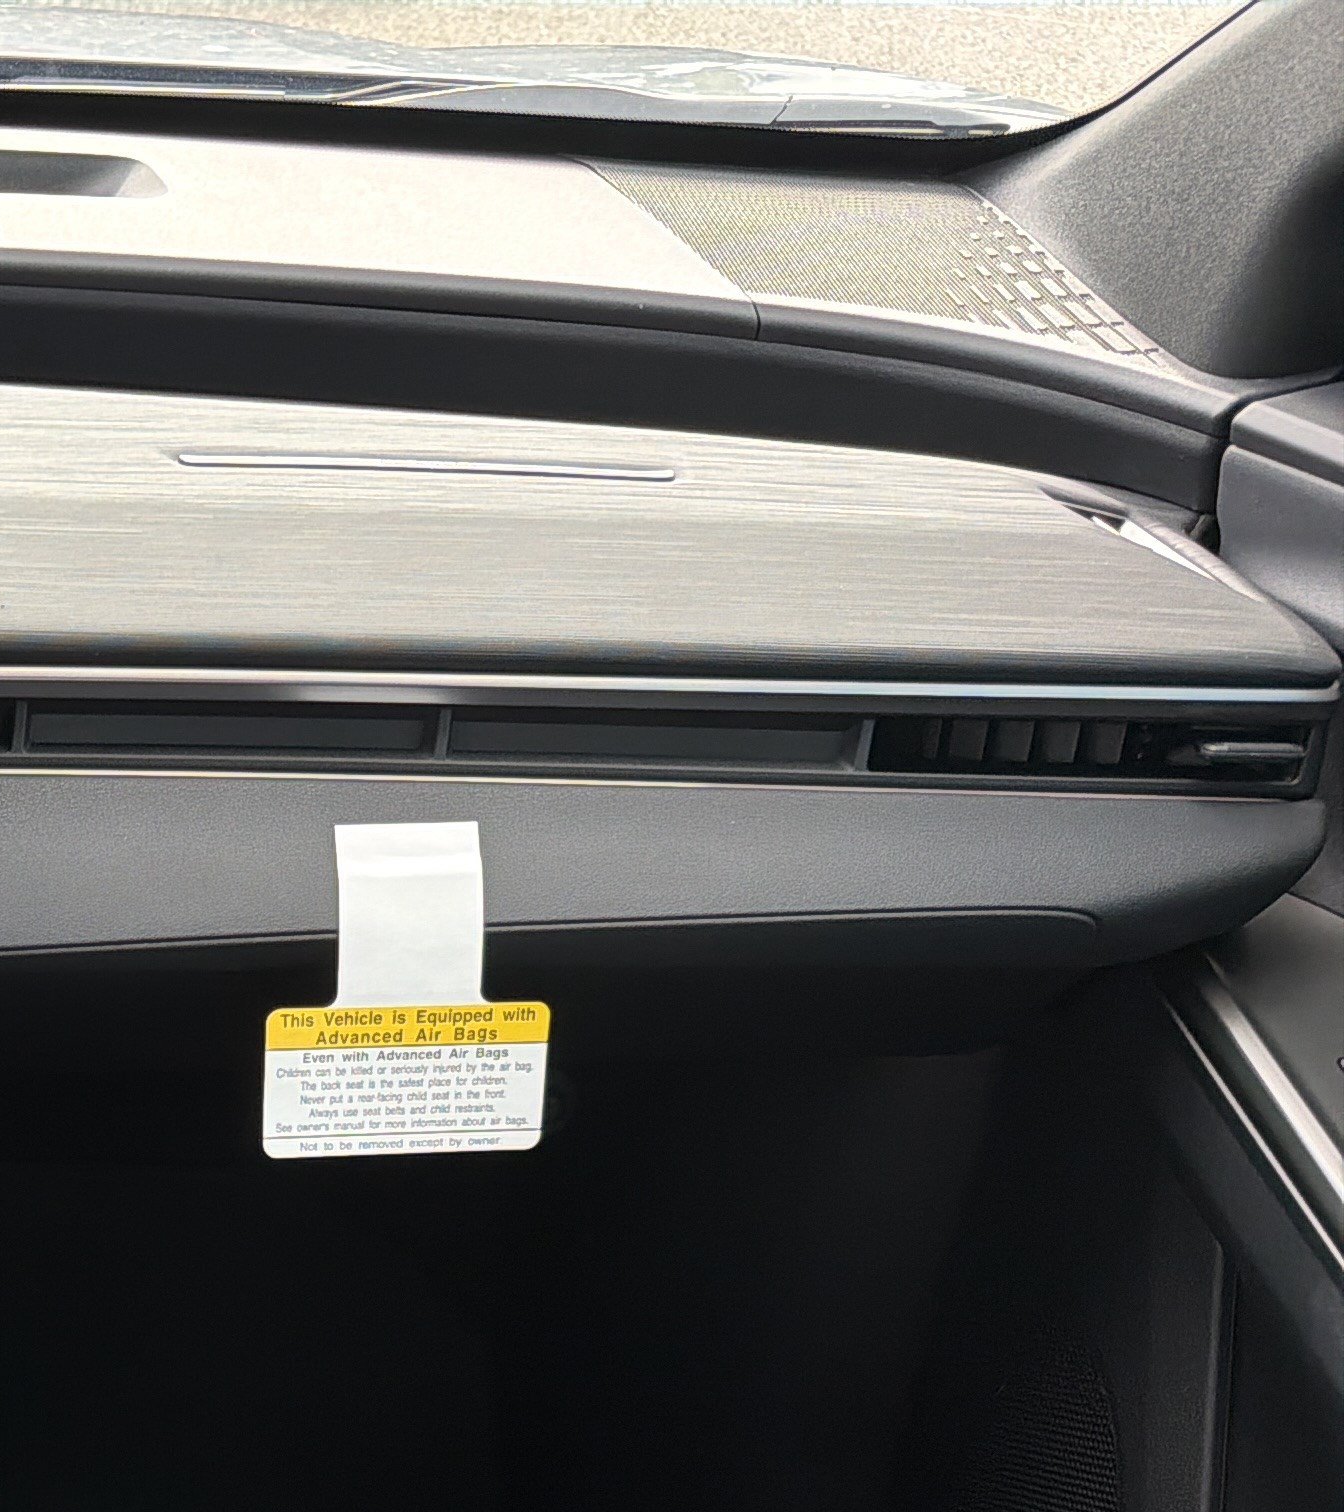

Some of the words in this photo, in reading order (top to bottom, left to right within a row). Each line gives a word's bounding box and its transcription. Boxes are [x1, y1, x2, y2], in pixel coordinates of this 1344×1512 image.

[280, 1013, 314, 1028] This
[324, 1010, 383, 1027] Vehicle
[392, 1010, 406, 1024] is
[416, 1008, 493, 1027] Equipped
[502, 1007, 536, 1021] with
[315, 1028, 403, 1045] Advanced
[415, 1028, 442, 1042] Air
[453, 1027, 498, 1042] Bags
[302, 1053, 335, 1064] Even
[341, 1051, 369, 1062] with
[376, 1049, 442, 1061] Advanced
[448, 1048, 469, 1059] Air
[475, 1047, 509, 1060] Bags
[276, 1068, 311, 1079] Children
[315, 1069, 331, 1077] can
[335, 1067, 346, 1076] be
[377, 1066, 387, 1075] or
[391, 1064, 429, 1076] seriously
[433, 1063, 462, 1074] injured
[466, 1063, 477, 1074] by
[481, 1062, 495, 1071] the
[499, 1062, 511, 1070] air
[301, 1081, 317, 1091] The
[320, 1080, 341, 1091] back
[346, 1080, 364, 1090] seat
[380, 1079, 392, 1088] the
[398, 1078, 424, 1088] safest
[428, 1078, 451, 1089] place
[456, 1077, 468, 1086] for
[299, 1095, 325, 1105] Never
[329, 1095, 344, 1105] put
[357, 1092, 402, 1104] rear-facing
[407, 1091, 427, 1101] child
[431, 1091, 450, 1100] seat
[454, 1090, 462, 1099] in
[466, 1090, 480, 1099] the
[308, 1108, 339, 1120] Always
[343, 1108, 359, 1117] use
[362, 1107, 381, 1116] seat
[385, 1106, 405, 1115] belts
[410, 1105, 426, 1114] and
[430, 1104, 451, 1114] child
[275, 1123, 292, 1133] See
[333, 1121, 365, 1131] manual
[369, 1120, 381, 1129] for
[384, 1120, 407, 1129] more
[410, 1118, 457, 1128] information
[461, 1117, 486, 1127] about
[490, 1116, 502, 1125] air
[299, 1142, 318, 1152] Not
[324, 1142, 333, 1151] to
[339, 1141, 352, 1150] be
[358, 1139, 404, 1150] removed
[408, 1138, 444, 1148] except
[448, 1137, 462, 1148] by
